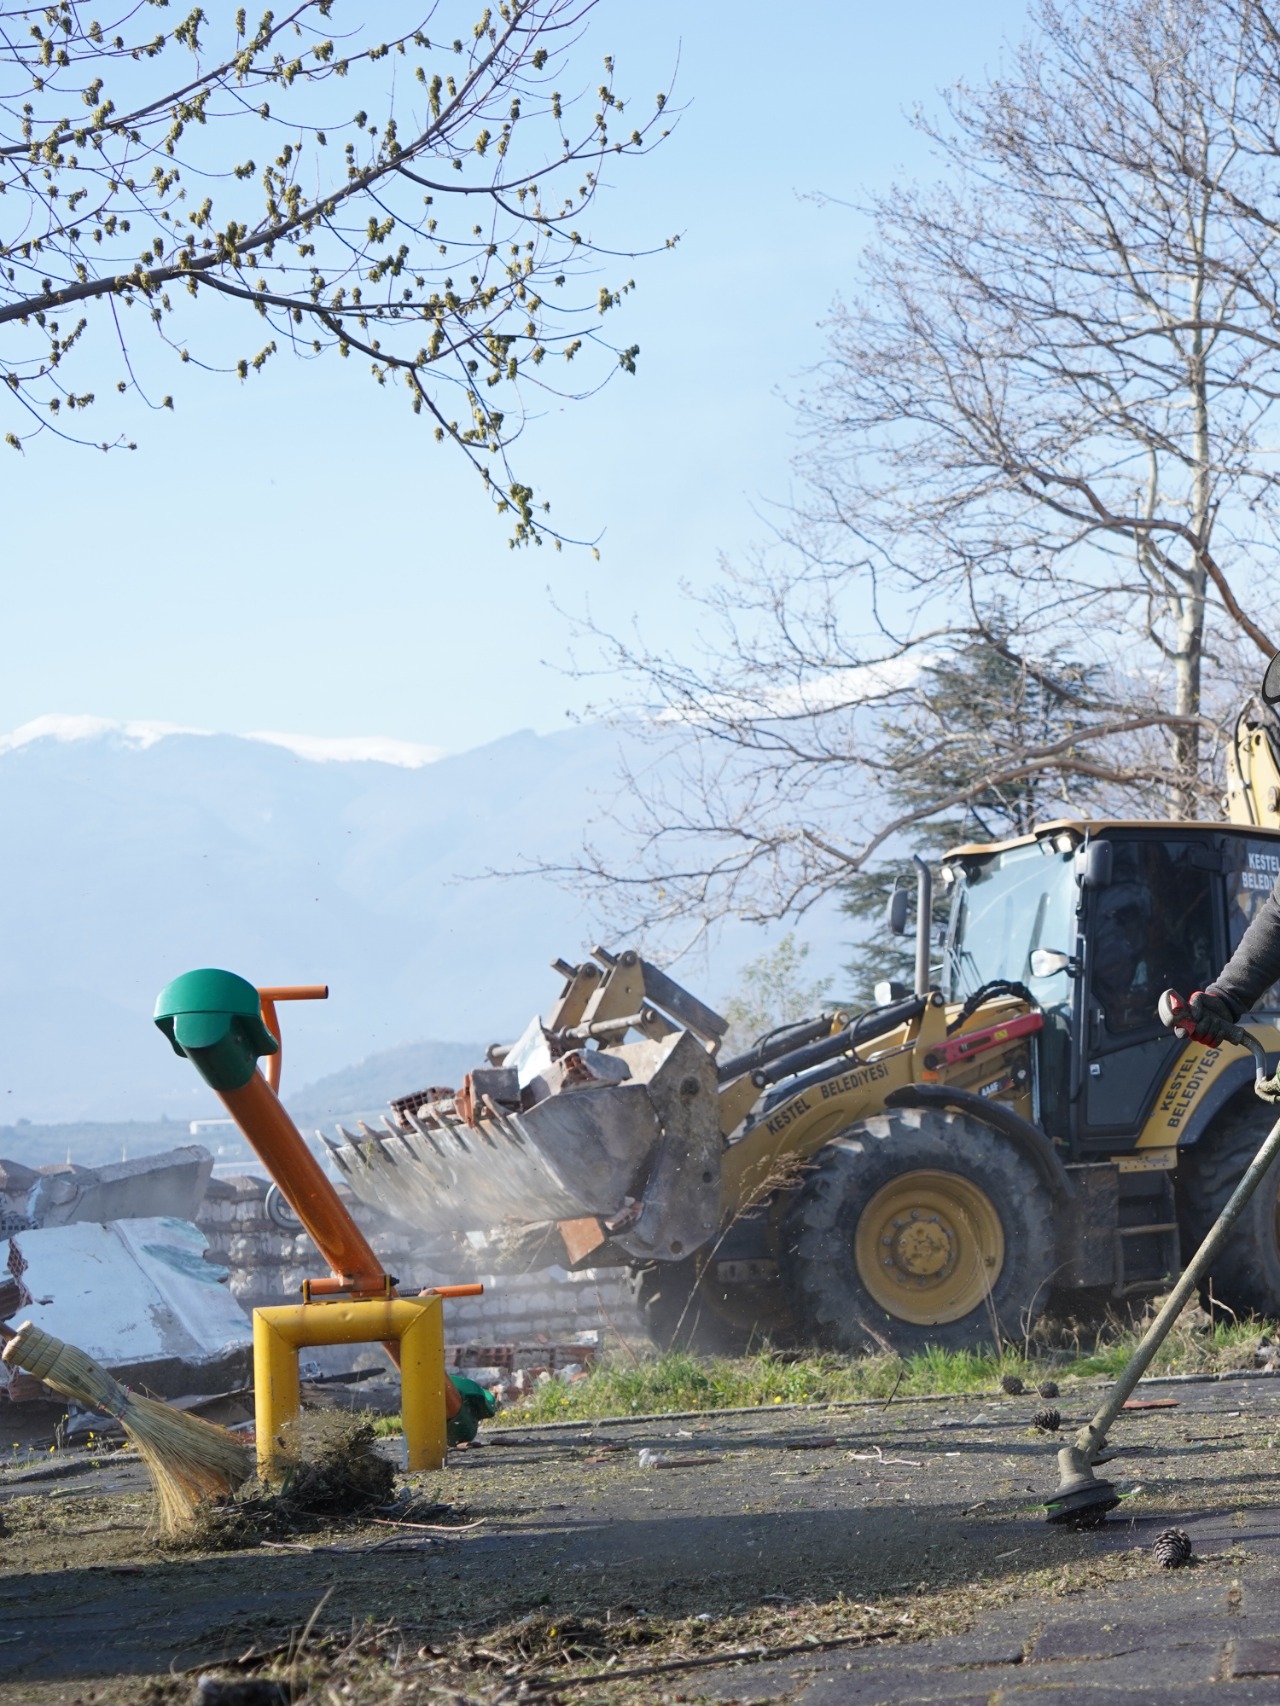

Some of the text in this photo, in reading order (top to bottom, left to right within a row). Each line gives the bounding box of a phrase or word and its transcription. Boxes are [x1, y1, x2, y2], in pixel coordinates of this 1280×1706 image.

[1248, 853, 1280, 872] KESTEL
[1160, 1055, 1198, 1111] KESTEL
[766, 1098, 811, 1135] KESTEL
